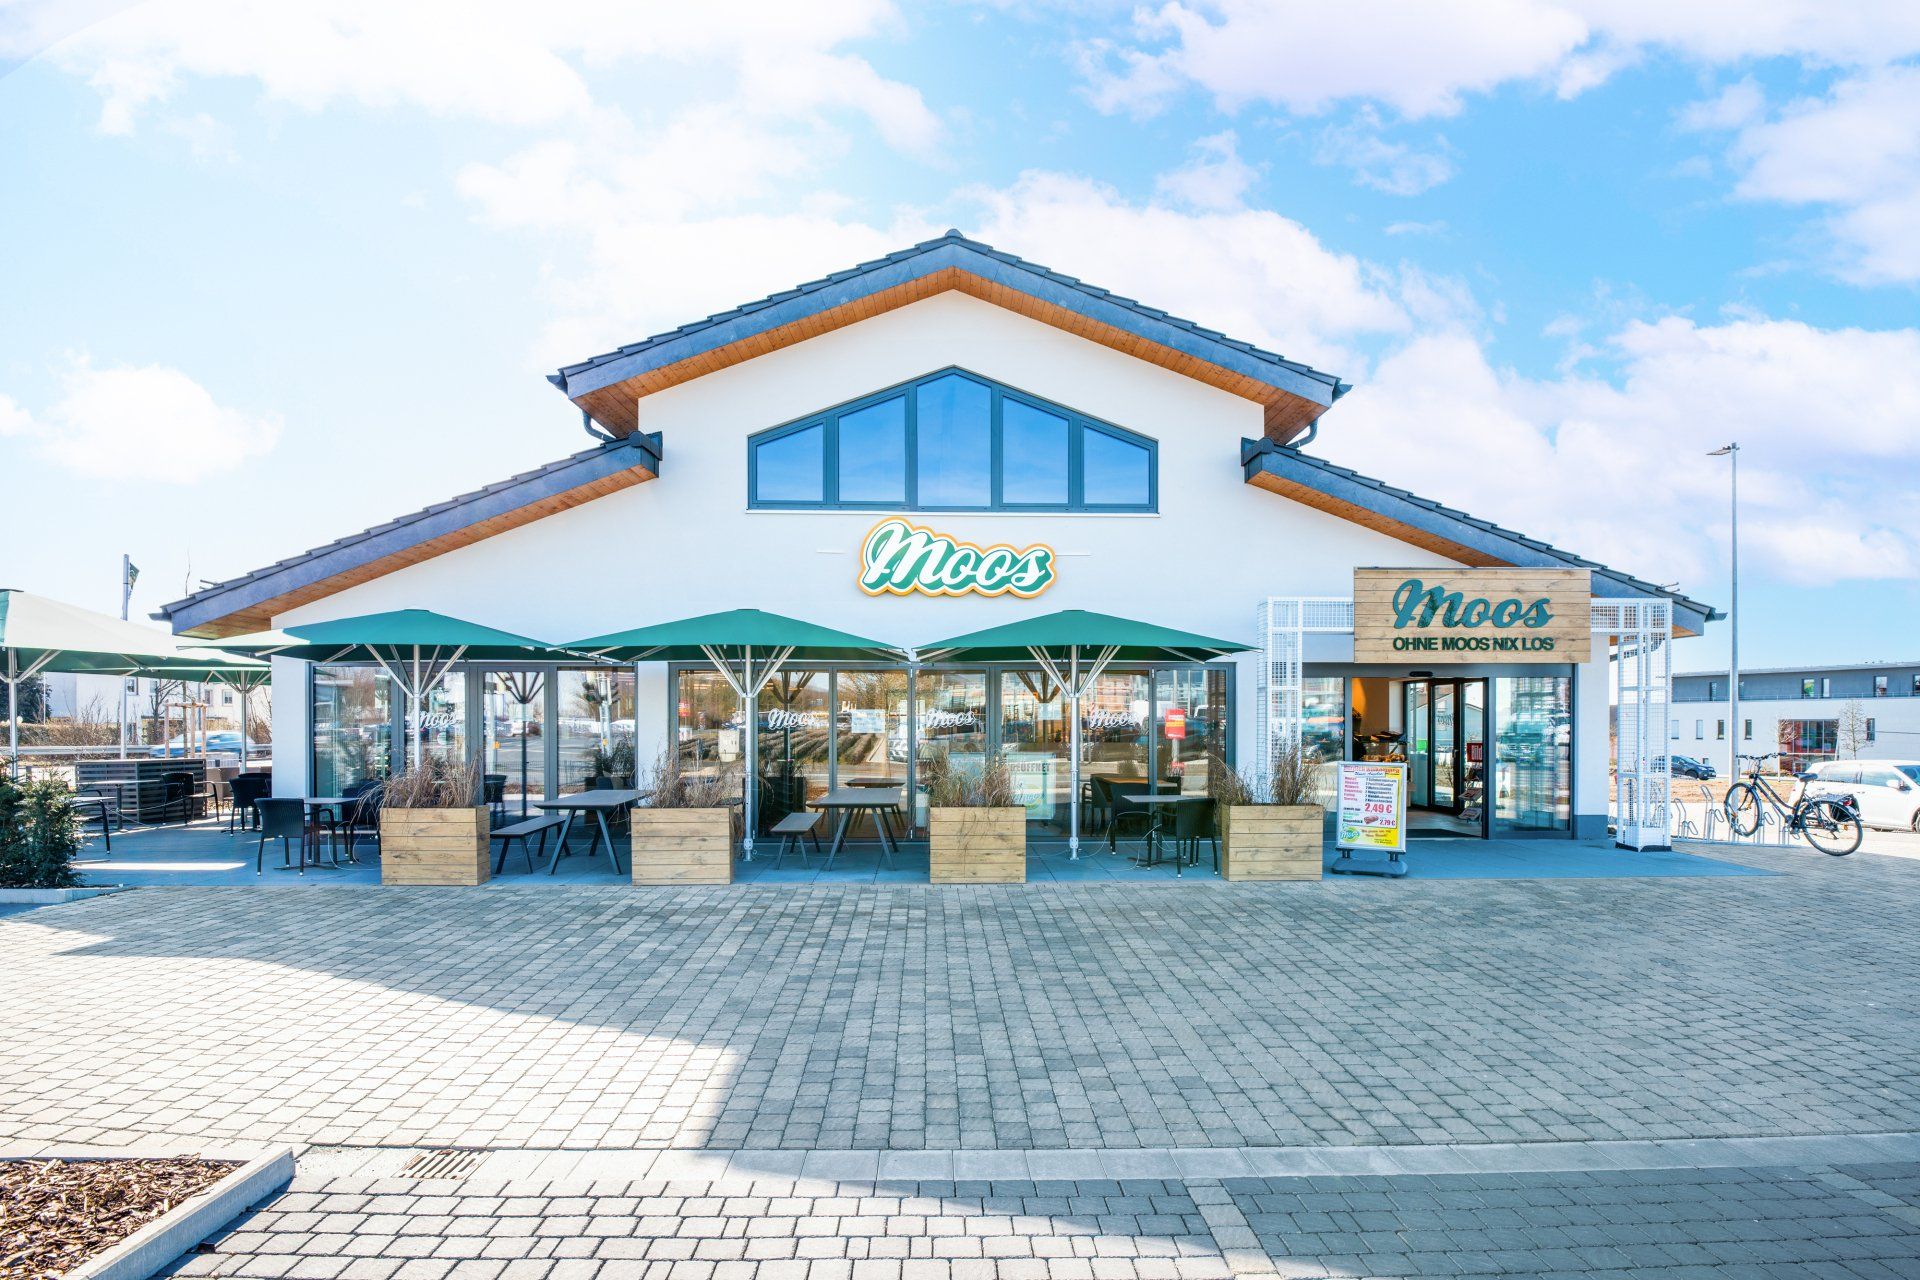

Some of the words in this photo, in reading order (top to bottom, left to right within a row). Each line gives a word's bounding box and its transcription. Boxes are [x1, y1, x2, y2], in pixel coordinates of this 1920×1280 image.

[862, 522, 1052, 592] Moos
[1392, 579, 1554, 629] Moos
[1393, 637, 1438, 651] OHNE
[1441, 637, 1490, 651] MOOS
[1493, 636, 1518, 651] NIX
[1522, 637, 1554, 651] LOS
[926, 708, 976, 729] Moos
[1364, 803, 1384, 813] 2,49
